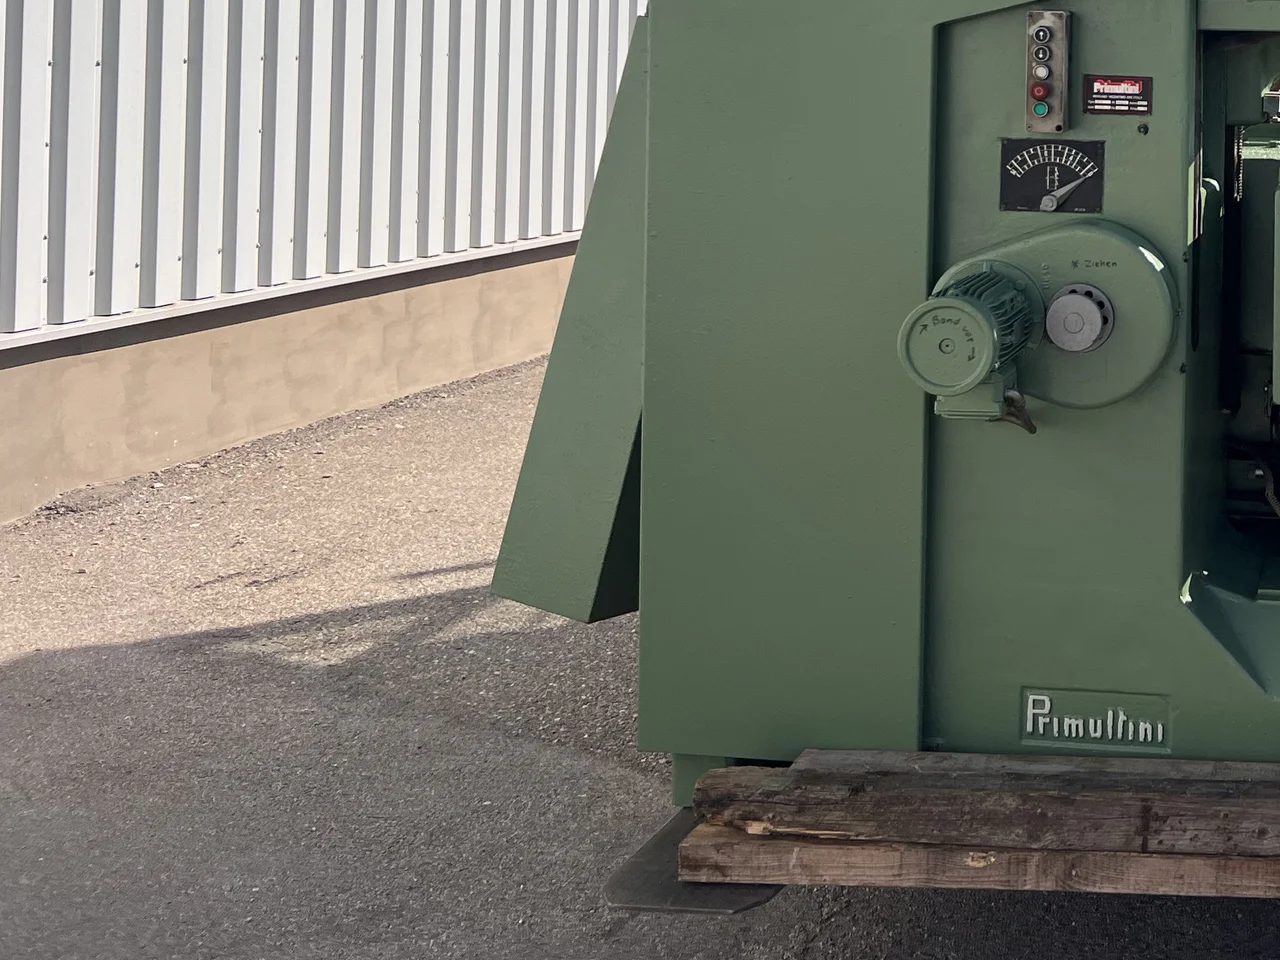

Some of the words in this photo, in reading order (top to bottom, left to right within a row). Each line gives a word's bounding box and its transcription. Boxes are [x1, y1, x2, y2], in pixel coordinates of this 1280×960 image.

[1084, 259, 1118, 268] Ziehen
[932, 315, 961, 326] Band
[1026, 694, 1165, 743] Primultini
